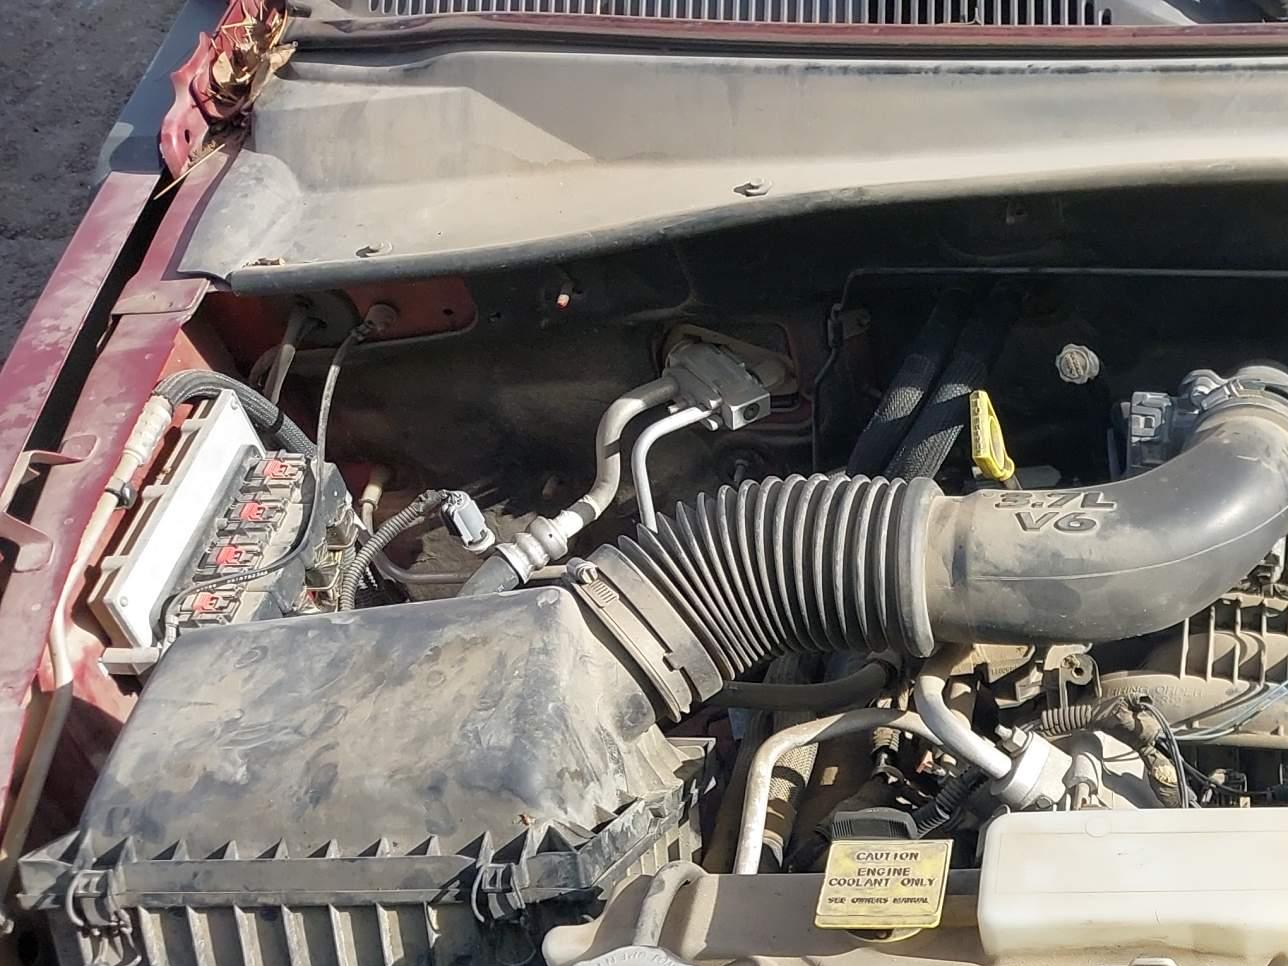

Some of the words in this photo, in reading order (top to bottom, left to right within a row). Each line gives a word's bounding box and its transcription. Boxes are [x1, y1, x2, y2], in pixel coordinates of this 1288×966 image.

[995, 491, 1118, 512] 3.7L
[1014, 511, 1100, 533] V6
[855, 851, 919, 861] CAUTION
[857, 867, 911, 877] ENGINE
[828, 877, 890, 887] COOLANT
[900, 877, 936, 887] ONLY
